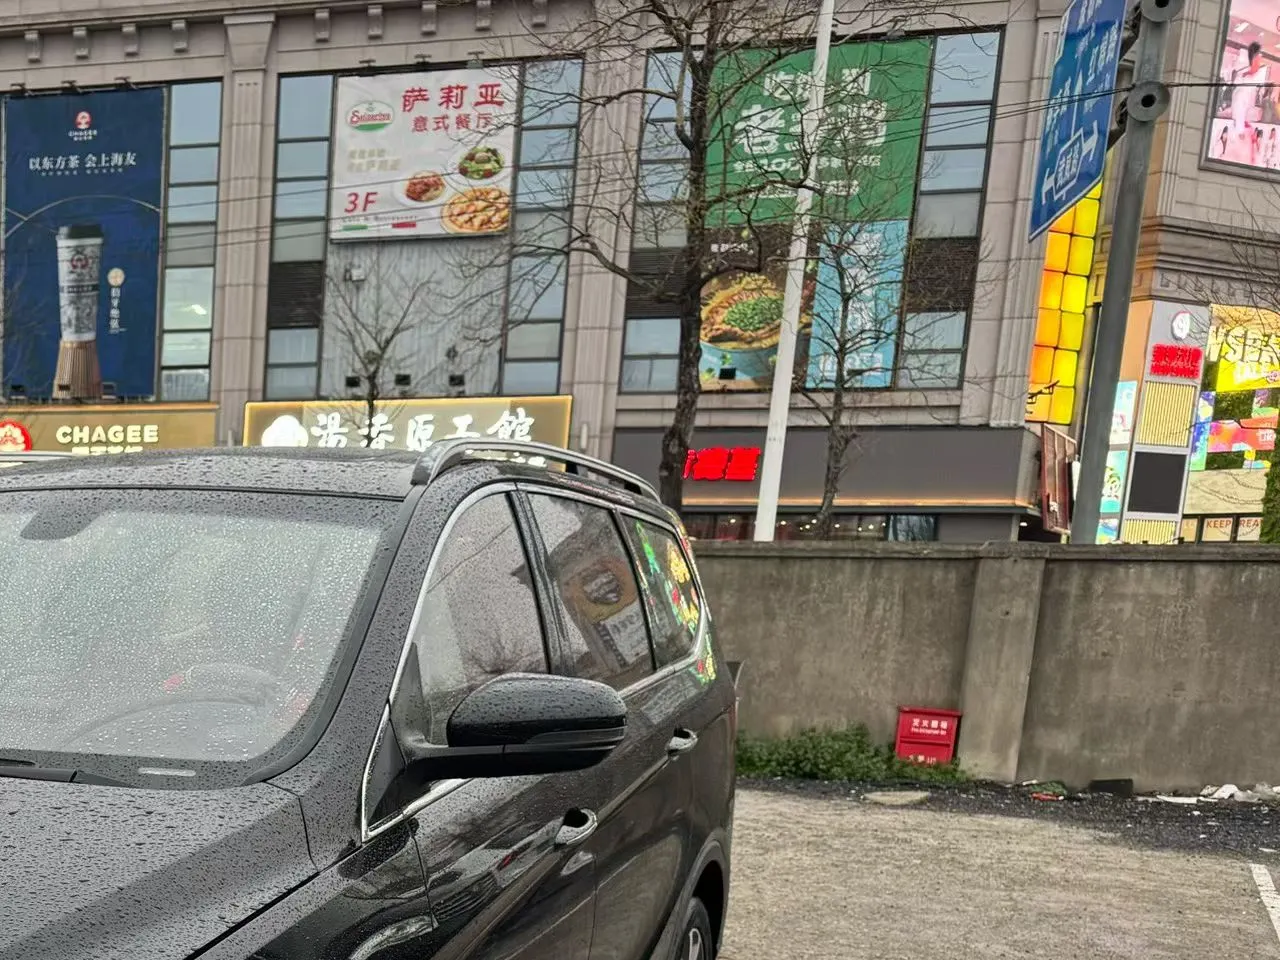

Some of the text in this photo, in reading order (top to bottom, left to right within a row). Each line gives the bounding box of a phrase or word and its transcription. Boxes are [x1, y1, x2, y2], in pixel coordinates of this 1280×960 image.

[401, 82, 505, 112] 萨莉亚
[412, 112, 494, 133] 意式餐厅
[28, 155, 80, 171] 以东方茶
[344, 191, 378, 213] 3F
[56, 425, 159, 444] CHAGEE
[1206, 519, 1231, 529] KEEP
